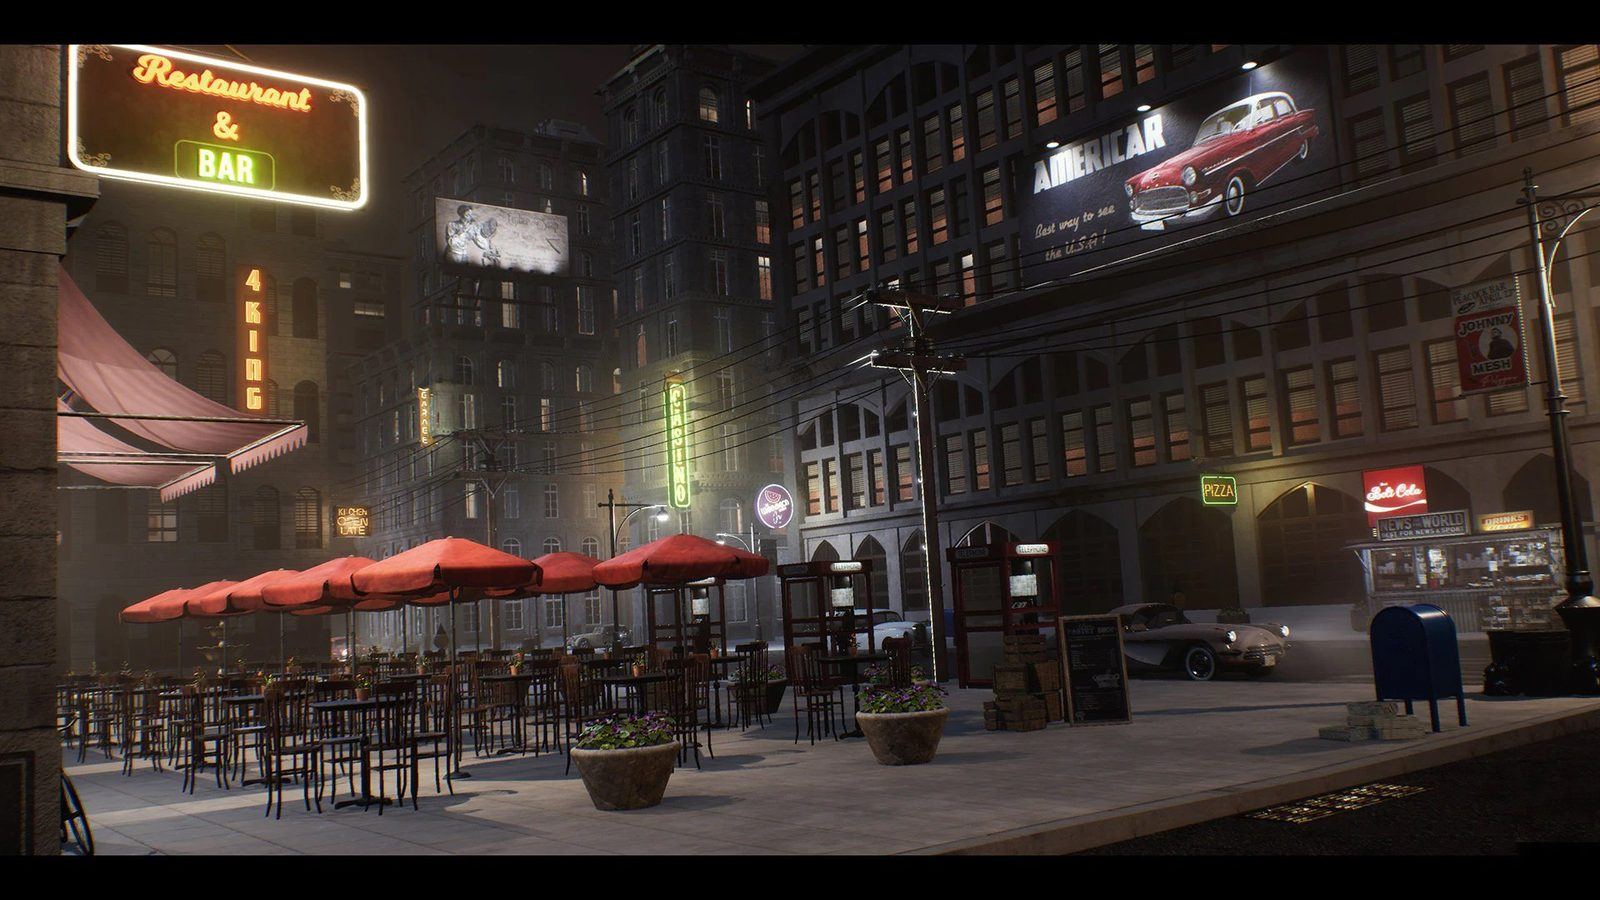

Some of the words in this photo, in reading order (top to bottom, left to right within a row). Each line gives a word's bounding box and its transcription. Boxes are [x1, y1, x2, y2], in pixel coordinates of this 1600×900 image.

[132, 54, 312, 113] Restaurant
[212, 111, 240, 141] &
[1033, 113, 1166, 195] AMERICAR
[197, 149, 255, 184] BAR
[1035, 223, 1056, 239] Best
[1059, 216, 1079, 234] way
[1082, 210, 1095, 222] to
[1097, 206, 1115, 218] see
[1045, 245, 1062, 261] the
[1459, 313, 1512, 336] JOHNNY
[1473, 359, 1511, 374] MESH
[672, 389, 685, 502] CASINO
[1205, 484, 1234, 497] PIZZA
[1395, 483, 1423, 498] Cola
[337, 508, 367, 516] KICHEN
[1485, 515, 1525, 525] DRINKS
[340, 525, 366, 535] LATE
[1380, 518, 1412, 532] NEWS
[1422, 512, 1464, 528] WORLD
[1399, 529, 1413, 537] FOR
